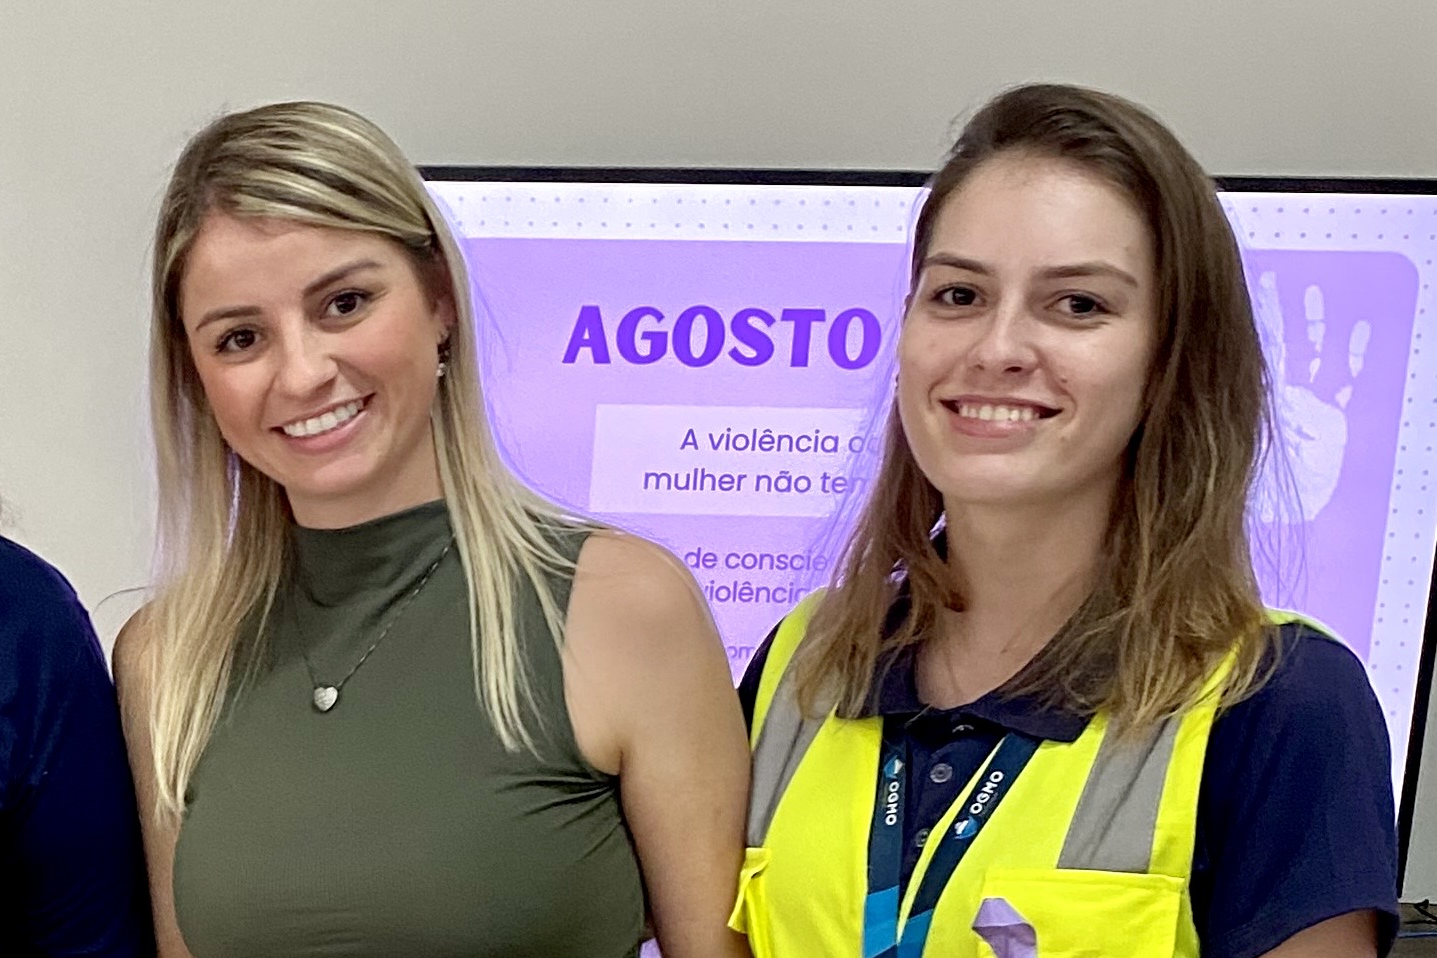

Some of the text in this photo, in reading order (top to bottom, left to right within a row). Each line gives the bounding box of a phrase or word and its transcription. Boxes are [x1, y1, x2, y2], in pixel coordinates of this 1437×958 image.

[562, 304, 882, 370] AGOSTO
[679, 428, 699, 450] A
[708, 427, 839, 453] violência
[643, 467, 747, 492] mulher
[754, 470, 812, 494] não
[684, 547, 717, 569] de
[885, 781, 900, 826] OGMO
[969, 770, 1004, 814] OGMO
